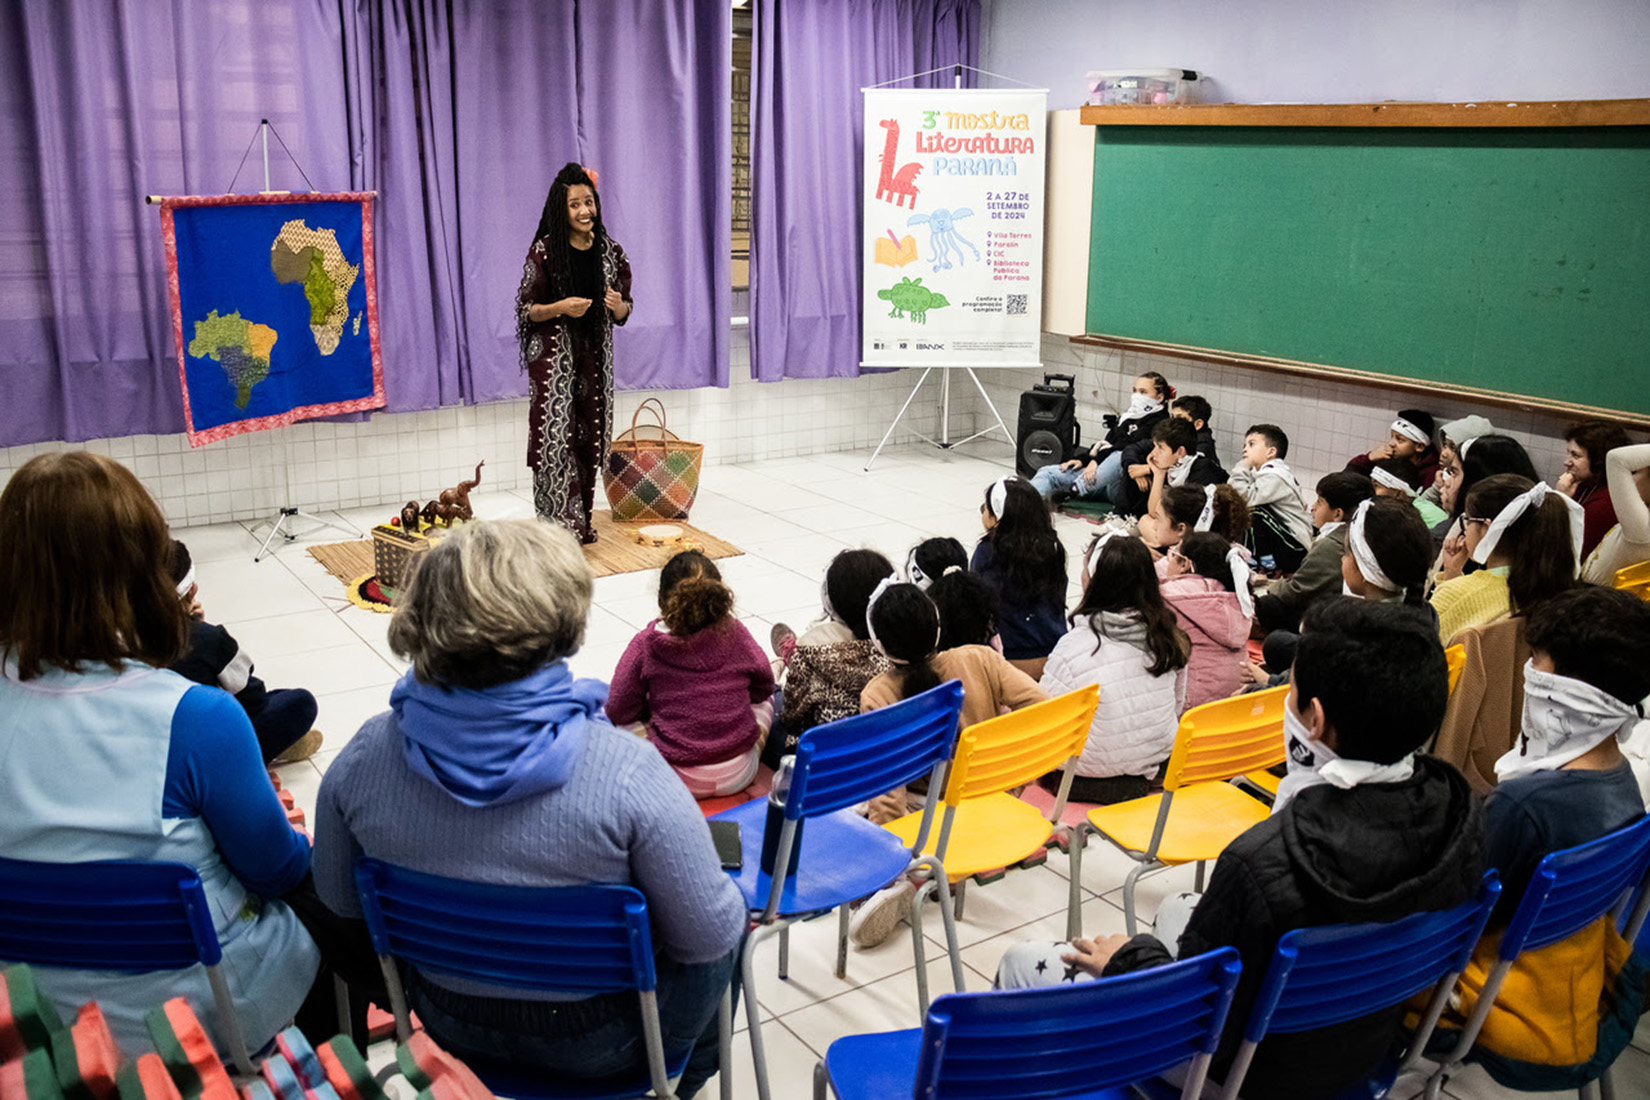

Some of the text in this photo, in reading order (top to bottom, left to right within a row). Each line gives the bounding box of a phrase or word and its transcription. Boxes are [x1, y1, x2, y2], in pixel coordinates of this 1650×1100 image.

[986, 191, 1030, 201] 2 A 27 DE
[986, 202, 1030, 210] SETEMBRO
[991, 211, 1026, 220] DE 2024
